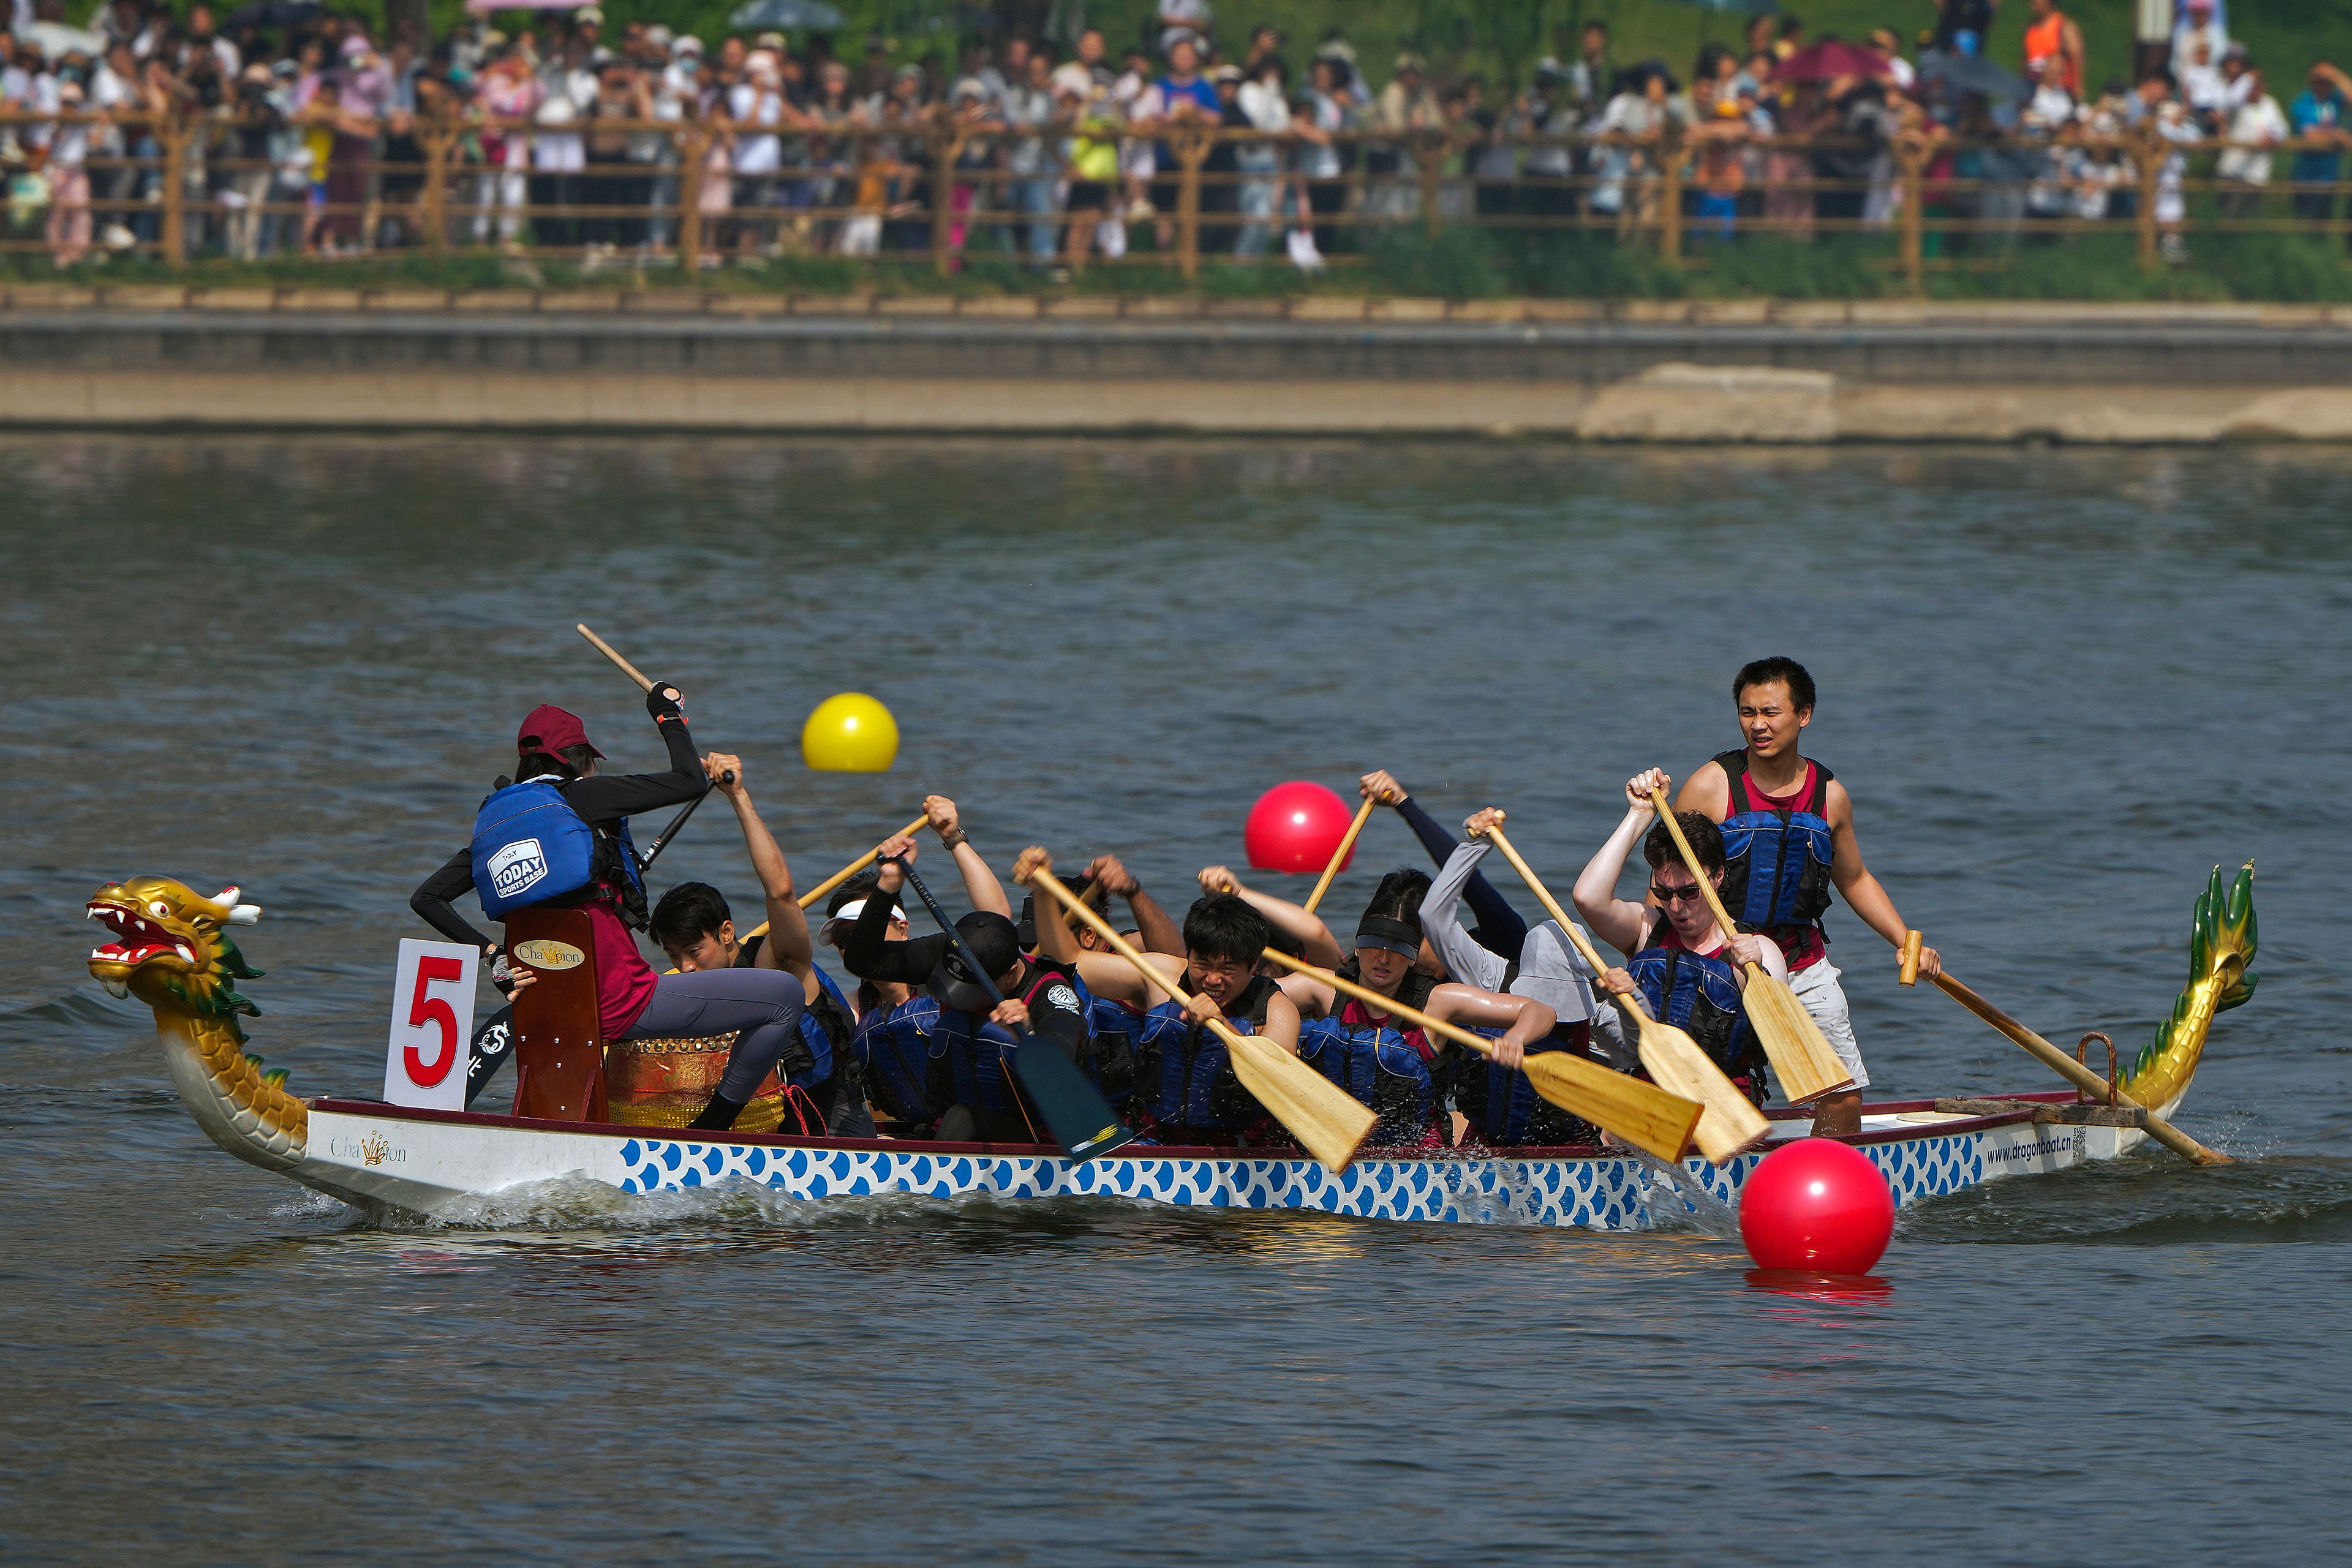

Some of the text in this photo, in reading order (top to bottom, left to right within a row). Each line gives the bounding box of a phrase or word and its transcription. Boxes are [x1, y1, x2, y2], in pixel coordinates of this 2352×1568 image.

[496, 857, 541, 888] TODAY
[499, 867, 544, 895] SPORTS BASE
[519, 945, 579, 964] Chapion
[402, 954, 463, 1089] 5
[331, 1136, 406, 1165] Chapion
[1987, 1136, 2071, 1164] www.dragonboat.cn
